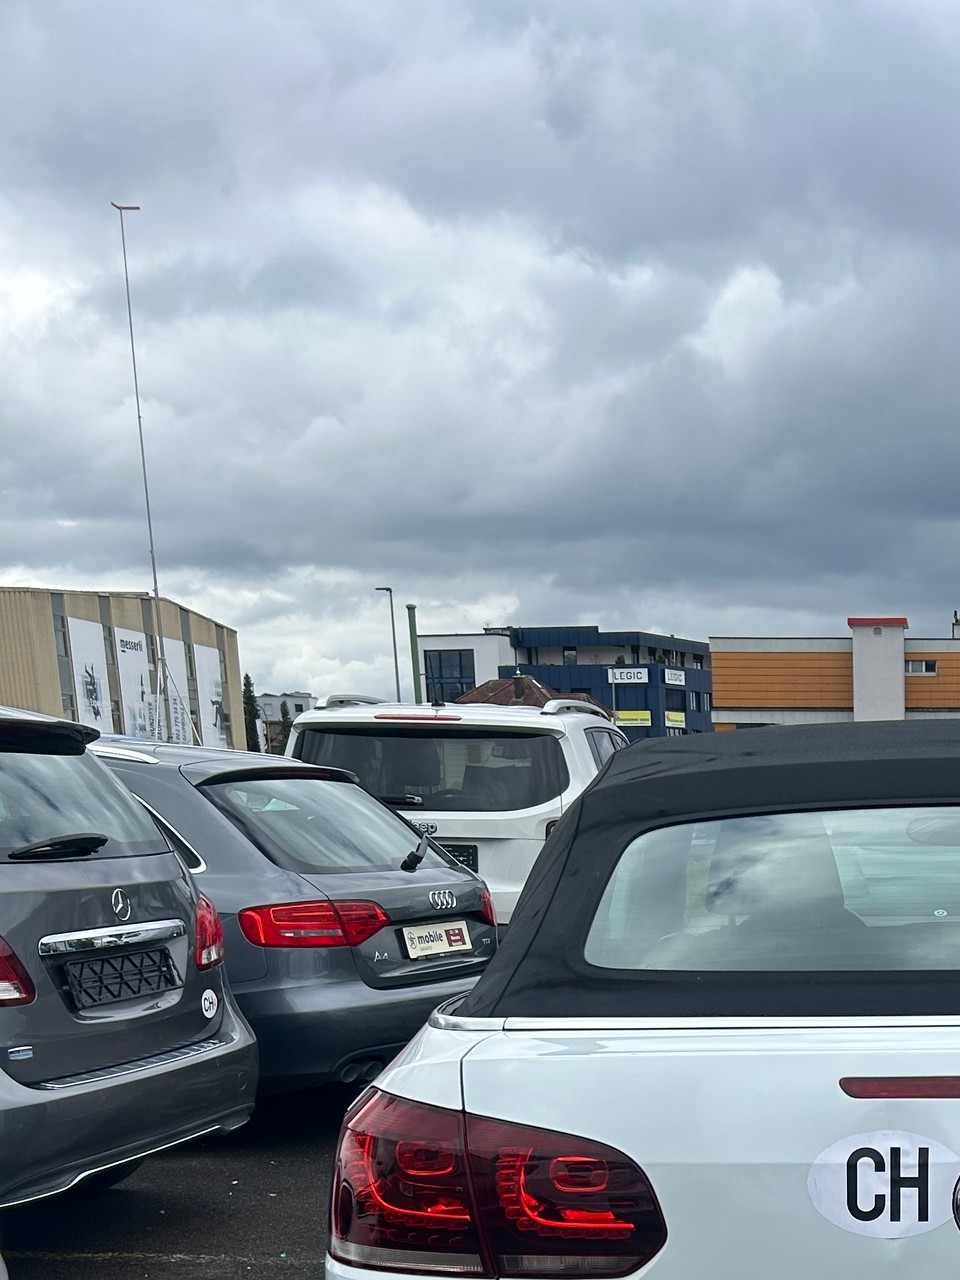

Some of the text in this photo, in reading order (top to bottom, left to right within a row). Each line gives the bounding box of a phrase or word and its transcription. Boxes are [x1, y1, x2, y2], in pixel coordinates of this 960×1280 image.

[614, 671, 643, 680] LEGIC
[667, 672, 682, 682] LEGIC
[417, 931, 443, 945] mobile
[374, 951, 389, 962] A4
[203, 996, 215, 1012] CH
[846, 1146, 930, 1223] CH
